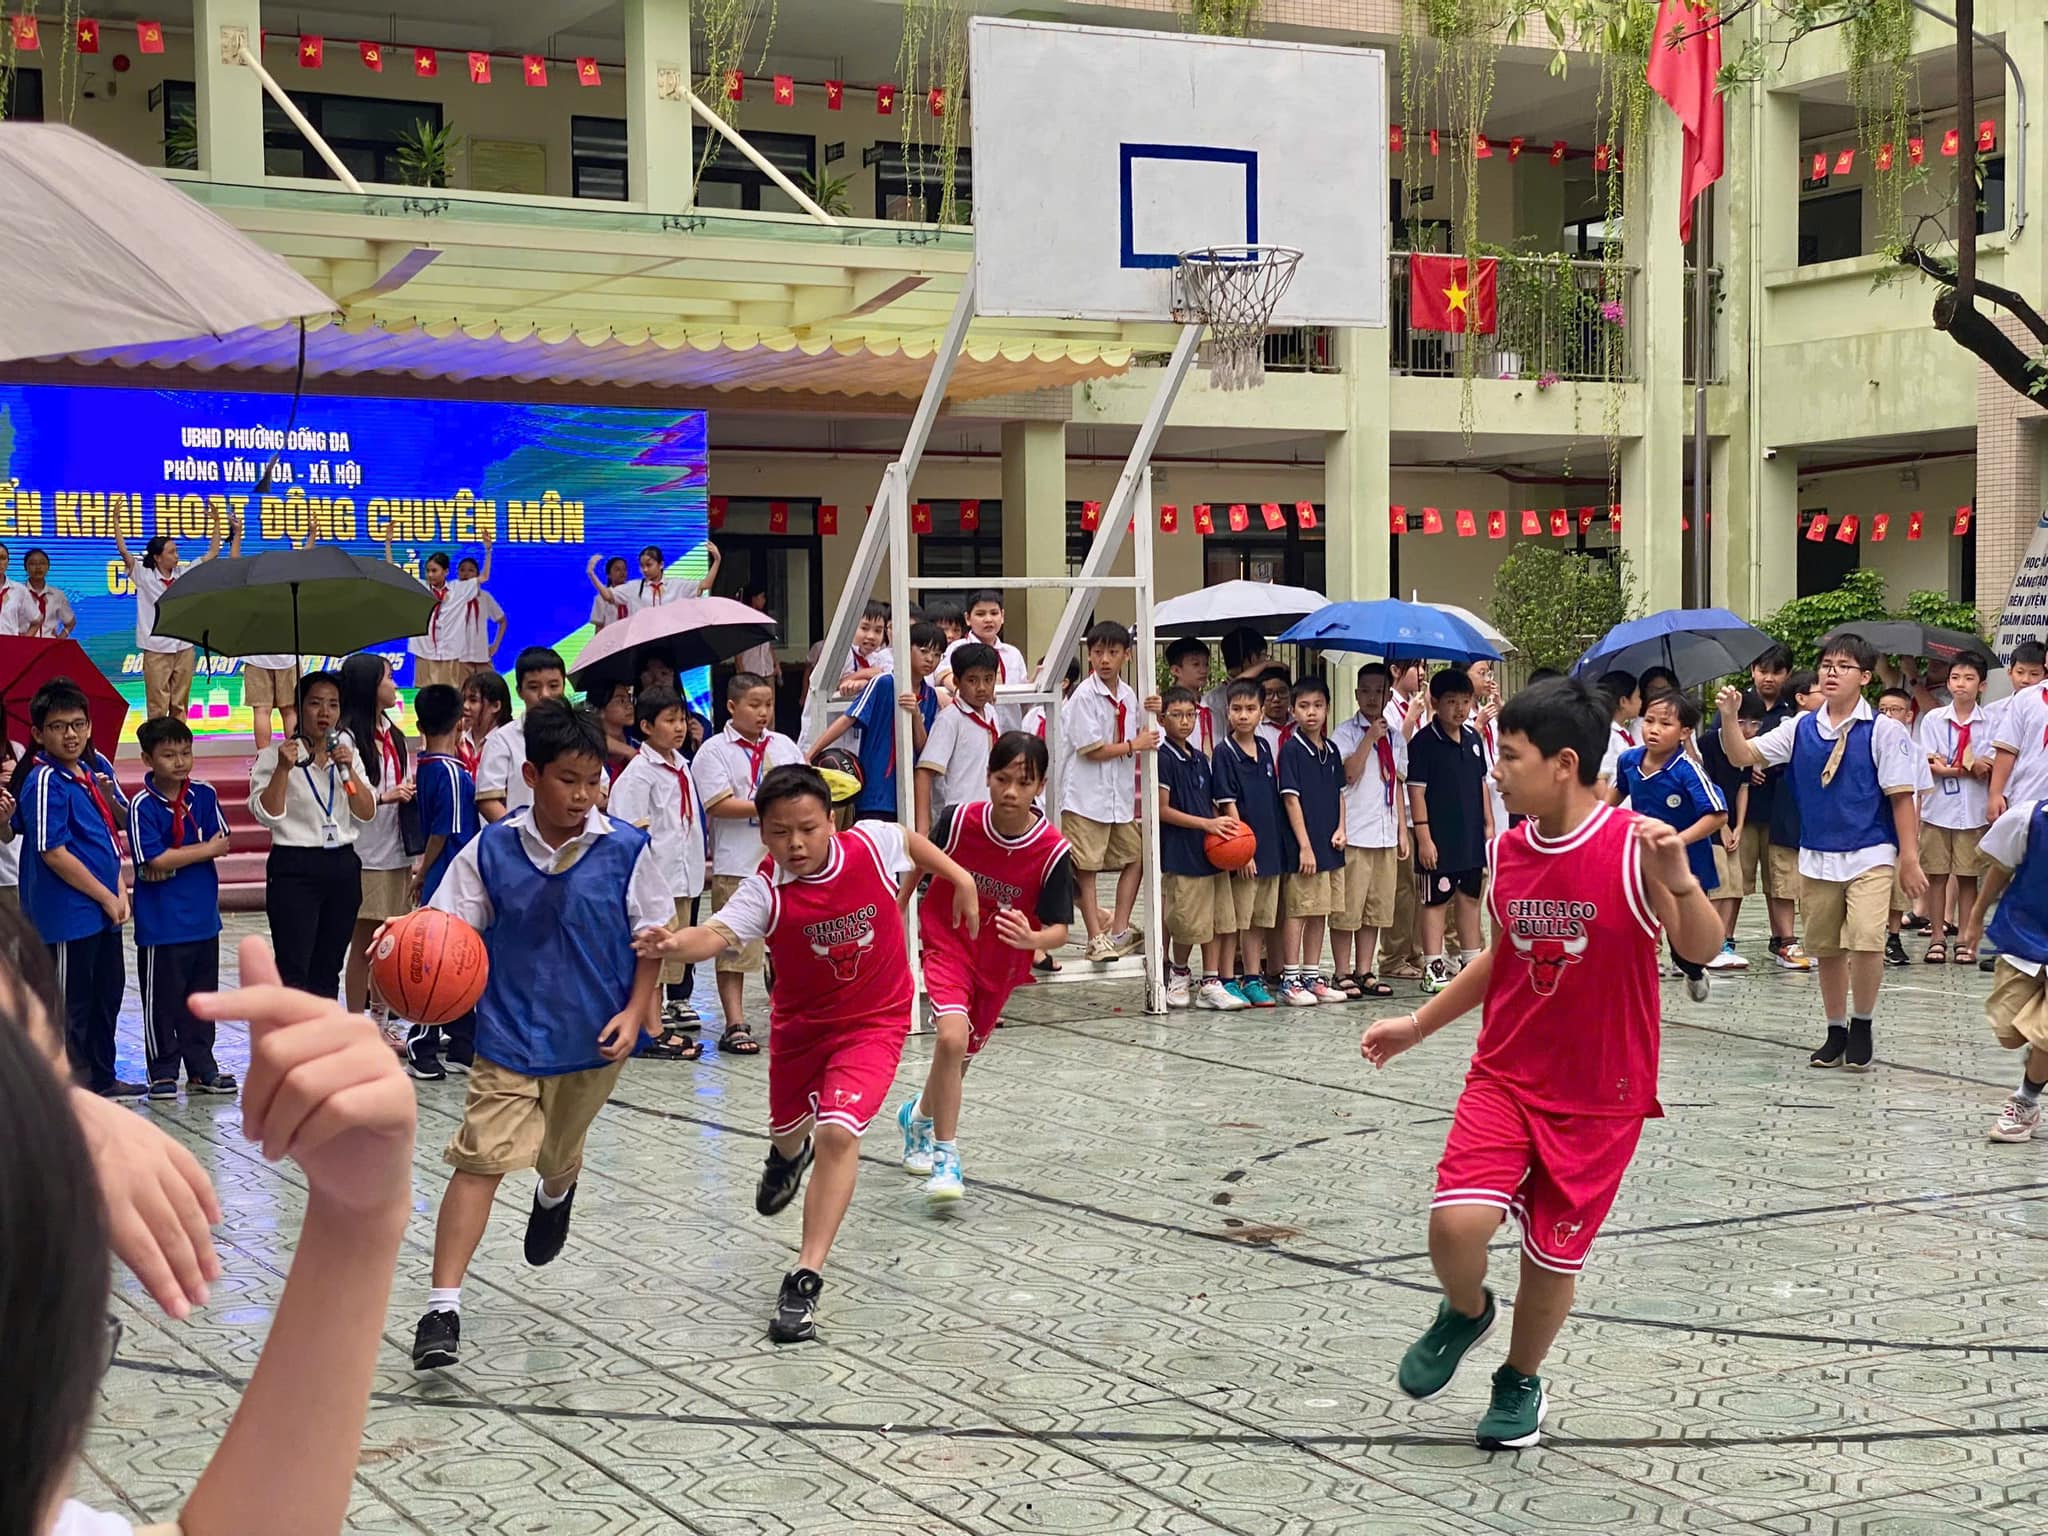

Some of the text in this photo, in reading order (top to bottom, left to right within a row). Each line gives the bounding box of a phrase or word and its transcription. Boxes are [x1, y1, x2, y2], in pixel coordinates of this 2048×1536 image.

[181, 427, 222, 448] UBND
[224, 424, 284, 450] PHƯỜNG
[329, 432, 351, 452] ĐA
[164, 456, 219, 481] PHÒNG
[223, 457, 256, 482] VĂN
[309, 460, 331, 484] XÃ
[335, 460, 361, 489] HỘI
[54, 491, 143, 538] KHAI
[260, 487, 357, 549] ĐỘNG
[367, 488, 497, 543] CHUYÊN
[507, 490, 585, 543] MÔN
[803, 903, 878, 937] CHICAGO
[1507, 899, 1598, 920] CHICAGO
[815, 920, 870, 945] BULLS
[1516, 918, 1581, 938] BULLS
